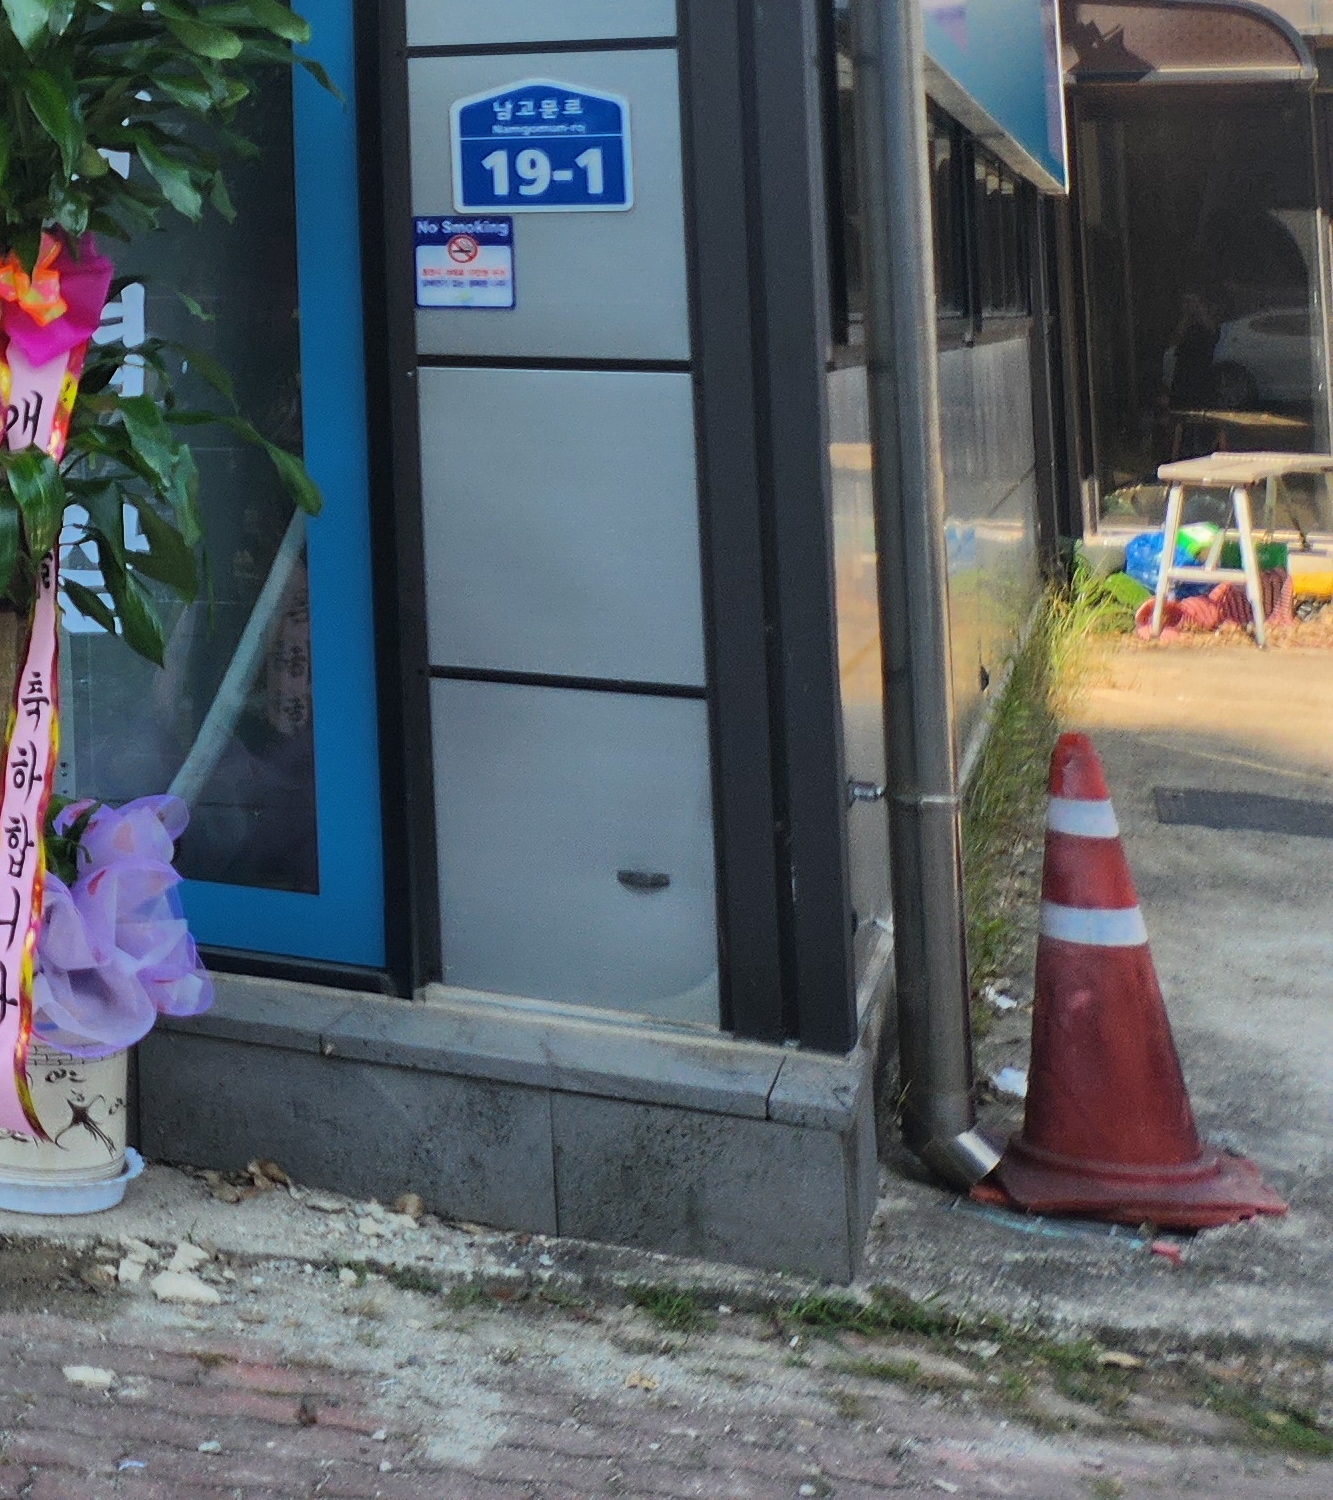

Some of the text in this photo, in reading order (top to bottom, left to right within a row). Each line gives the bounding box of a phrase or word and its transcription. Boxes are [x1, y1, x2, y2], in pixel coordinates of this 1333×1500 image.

[481, 147, 605, 196] 19-1
[416, 219, 509, 237] No Smoking
